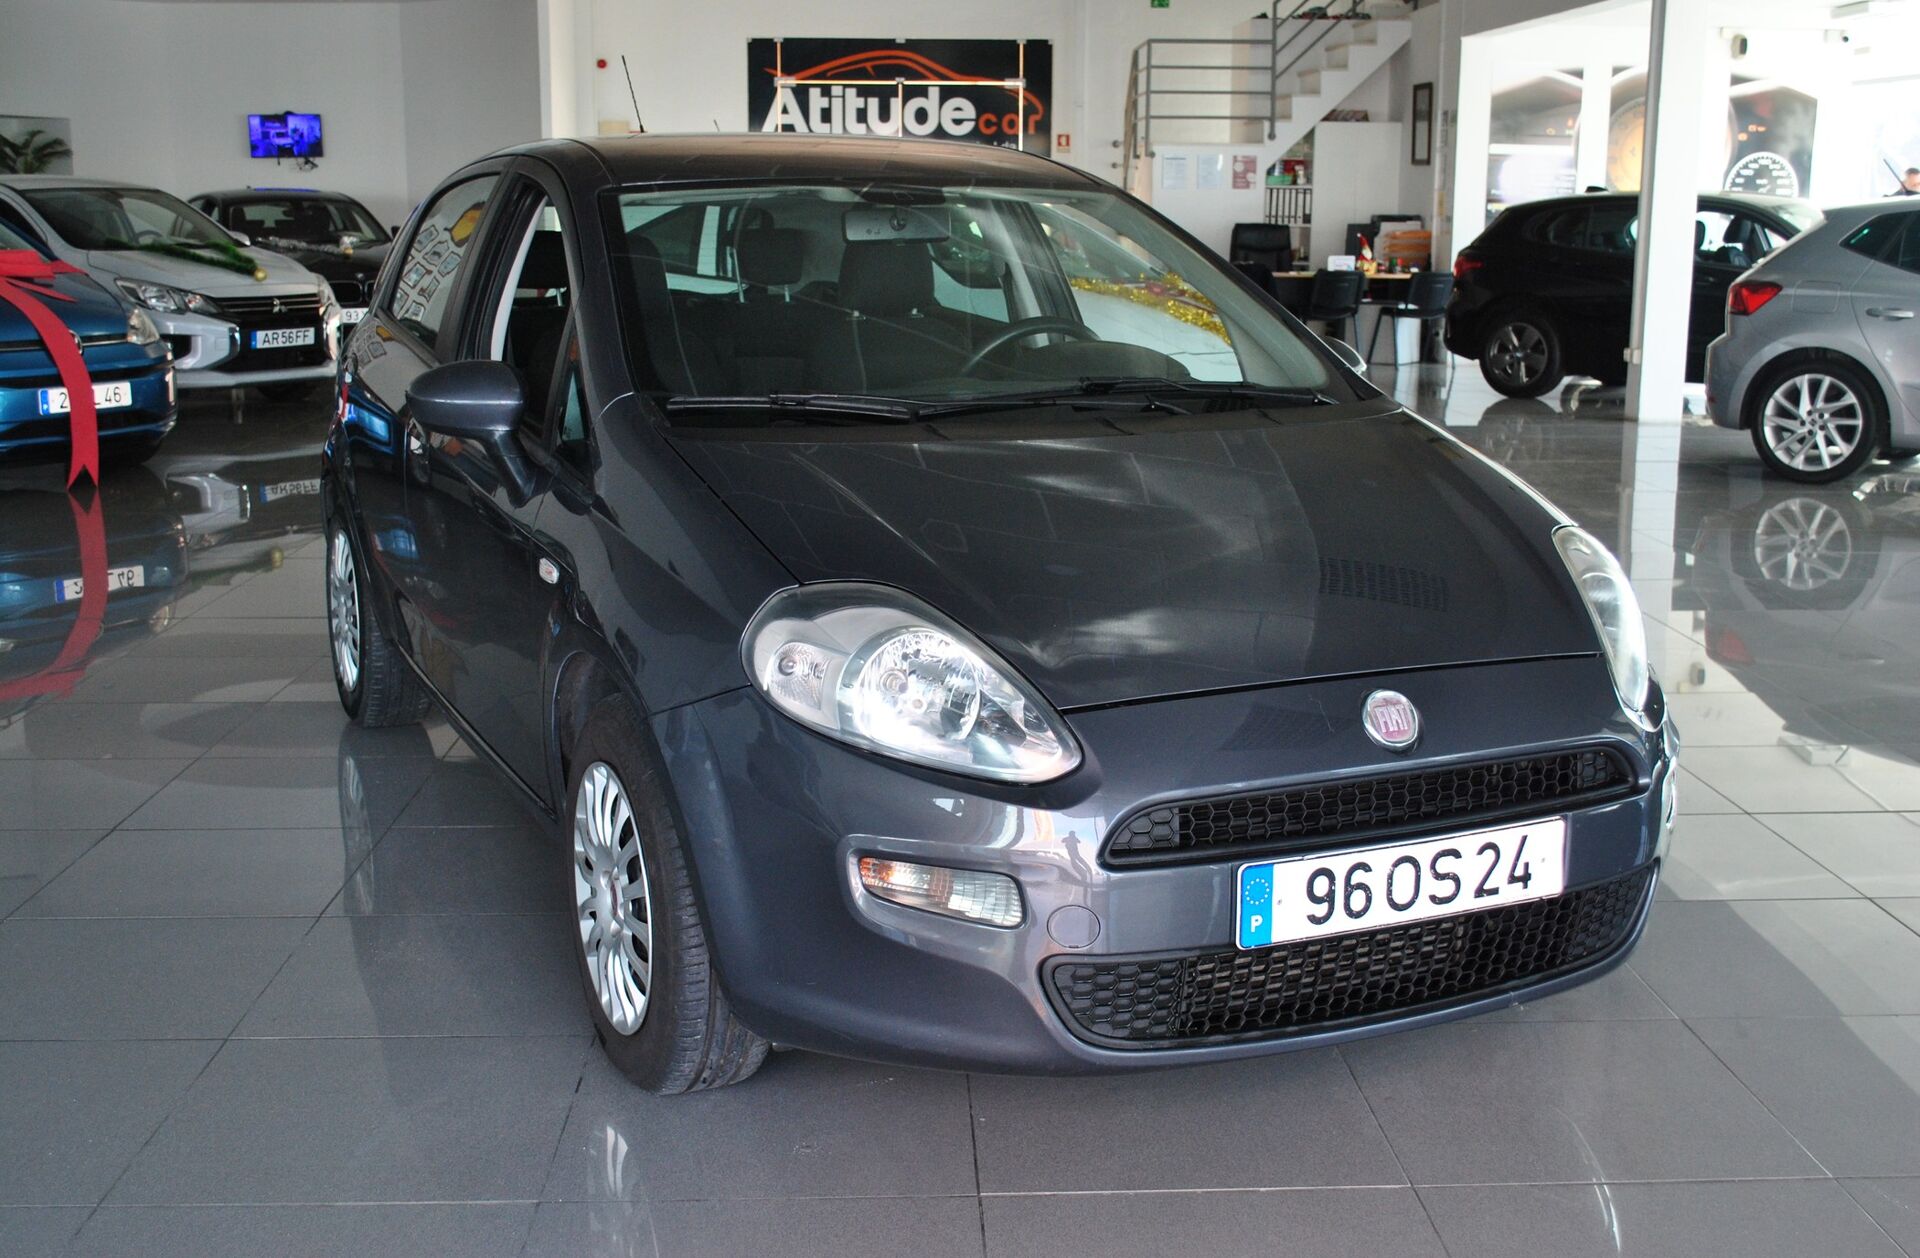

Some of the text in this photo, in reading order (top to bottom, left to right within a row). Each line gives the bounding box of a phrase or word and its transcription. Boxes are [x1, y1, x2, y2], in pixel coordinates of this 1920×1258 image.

[761, 86, 976, 136] Atitude
[262, 329, 311, 345] AR56FF
[1373, 703, 1408, 733] FIAT
[1250, 914, 1263, 933] P
